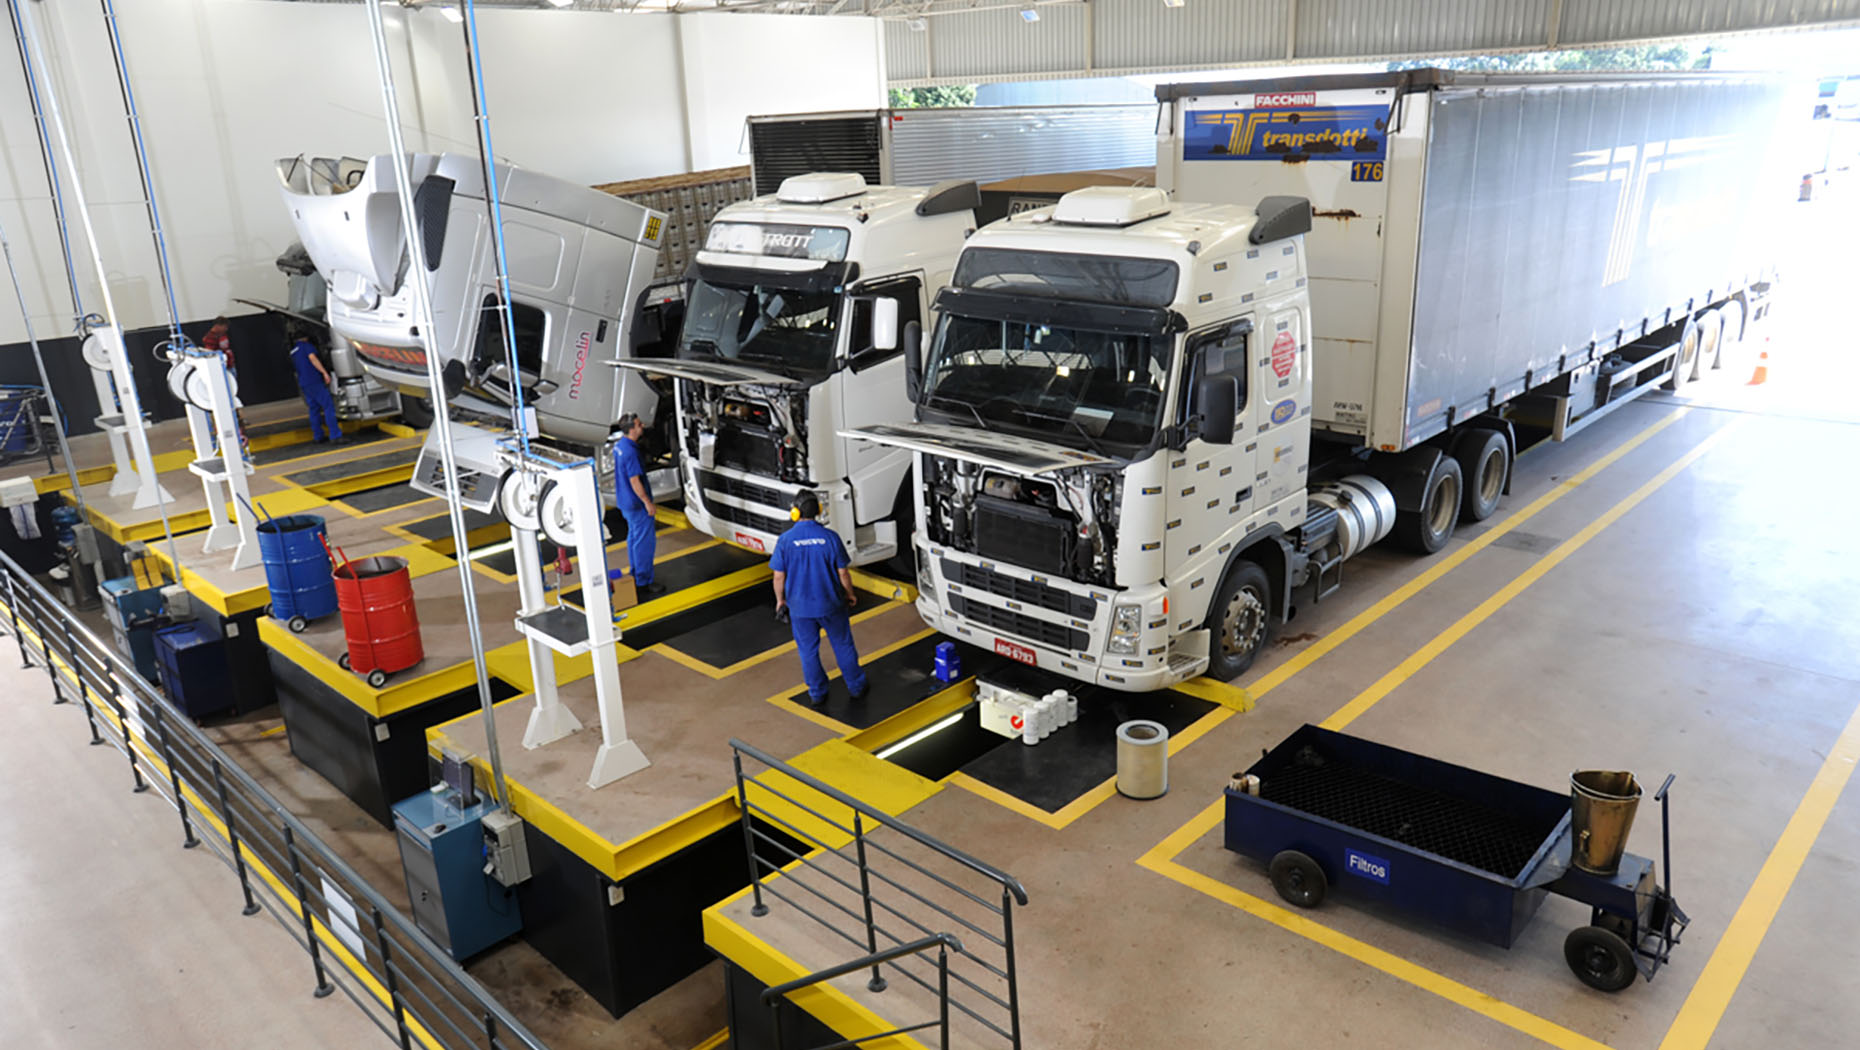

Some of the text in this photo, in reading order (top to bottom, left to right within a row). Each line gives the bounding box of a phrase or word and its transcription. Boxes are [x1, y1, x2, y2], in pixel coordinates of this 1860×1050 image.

[1256, 94, 1314, 105] FACCHINI
[1262, 128, 1367, 147] transdotti
[1353, 163, 1383, 181] 176
[568, 331, 592, 400] mocelin
[1350, 854, 1386, 878] Filtros
